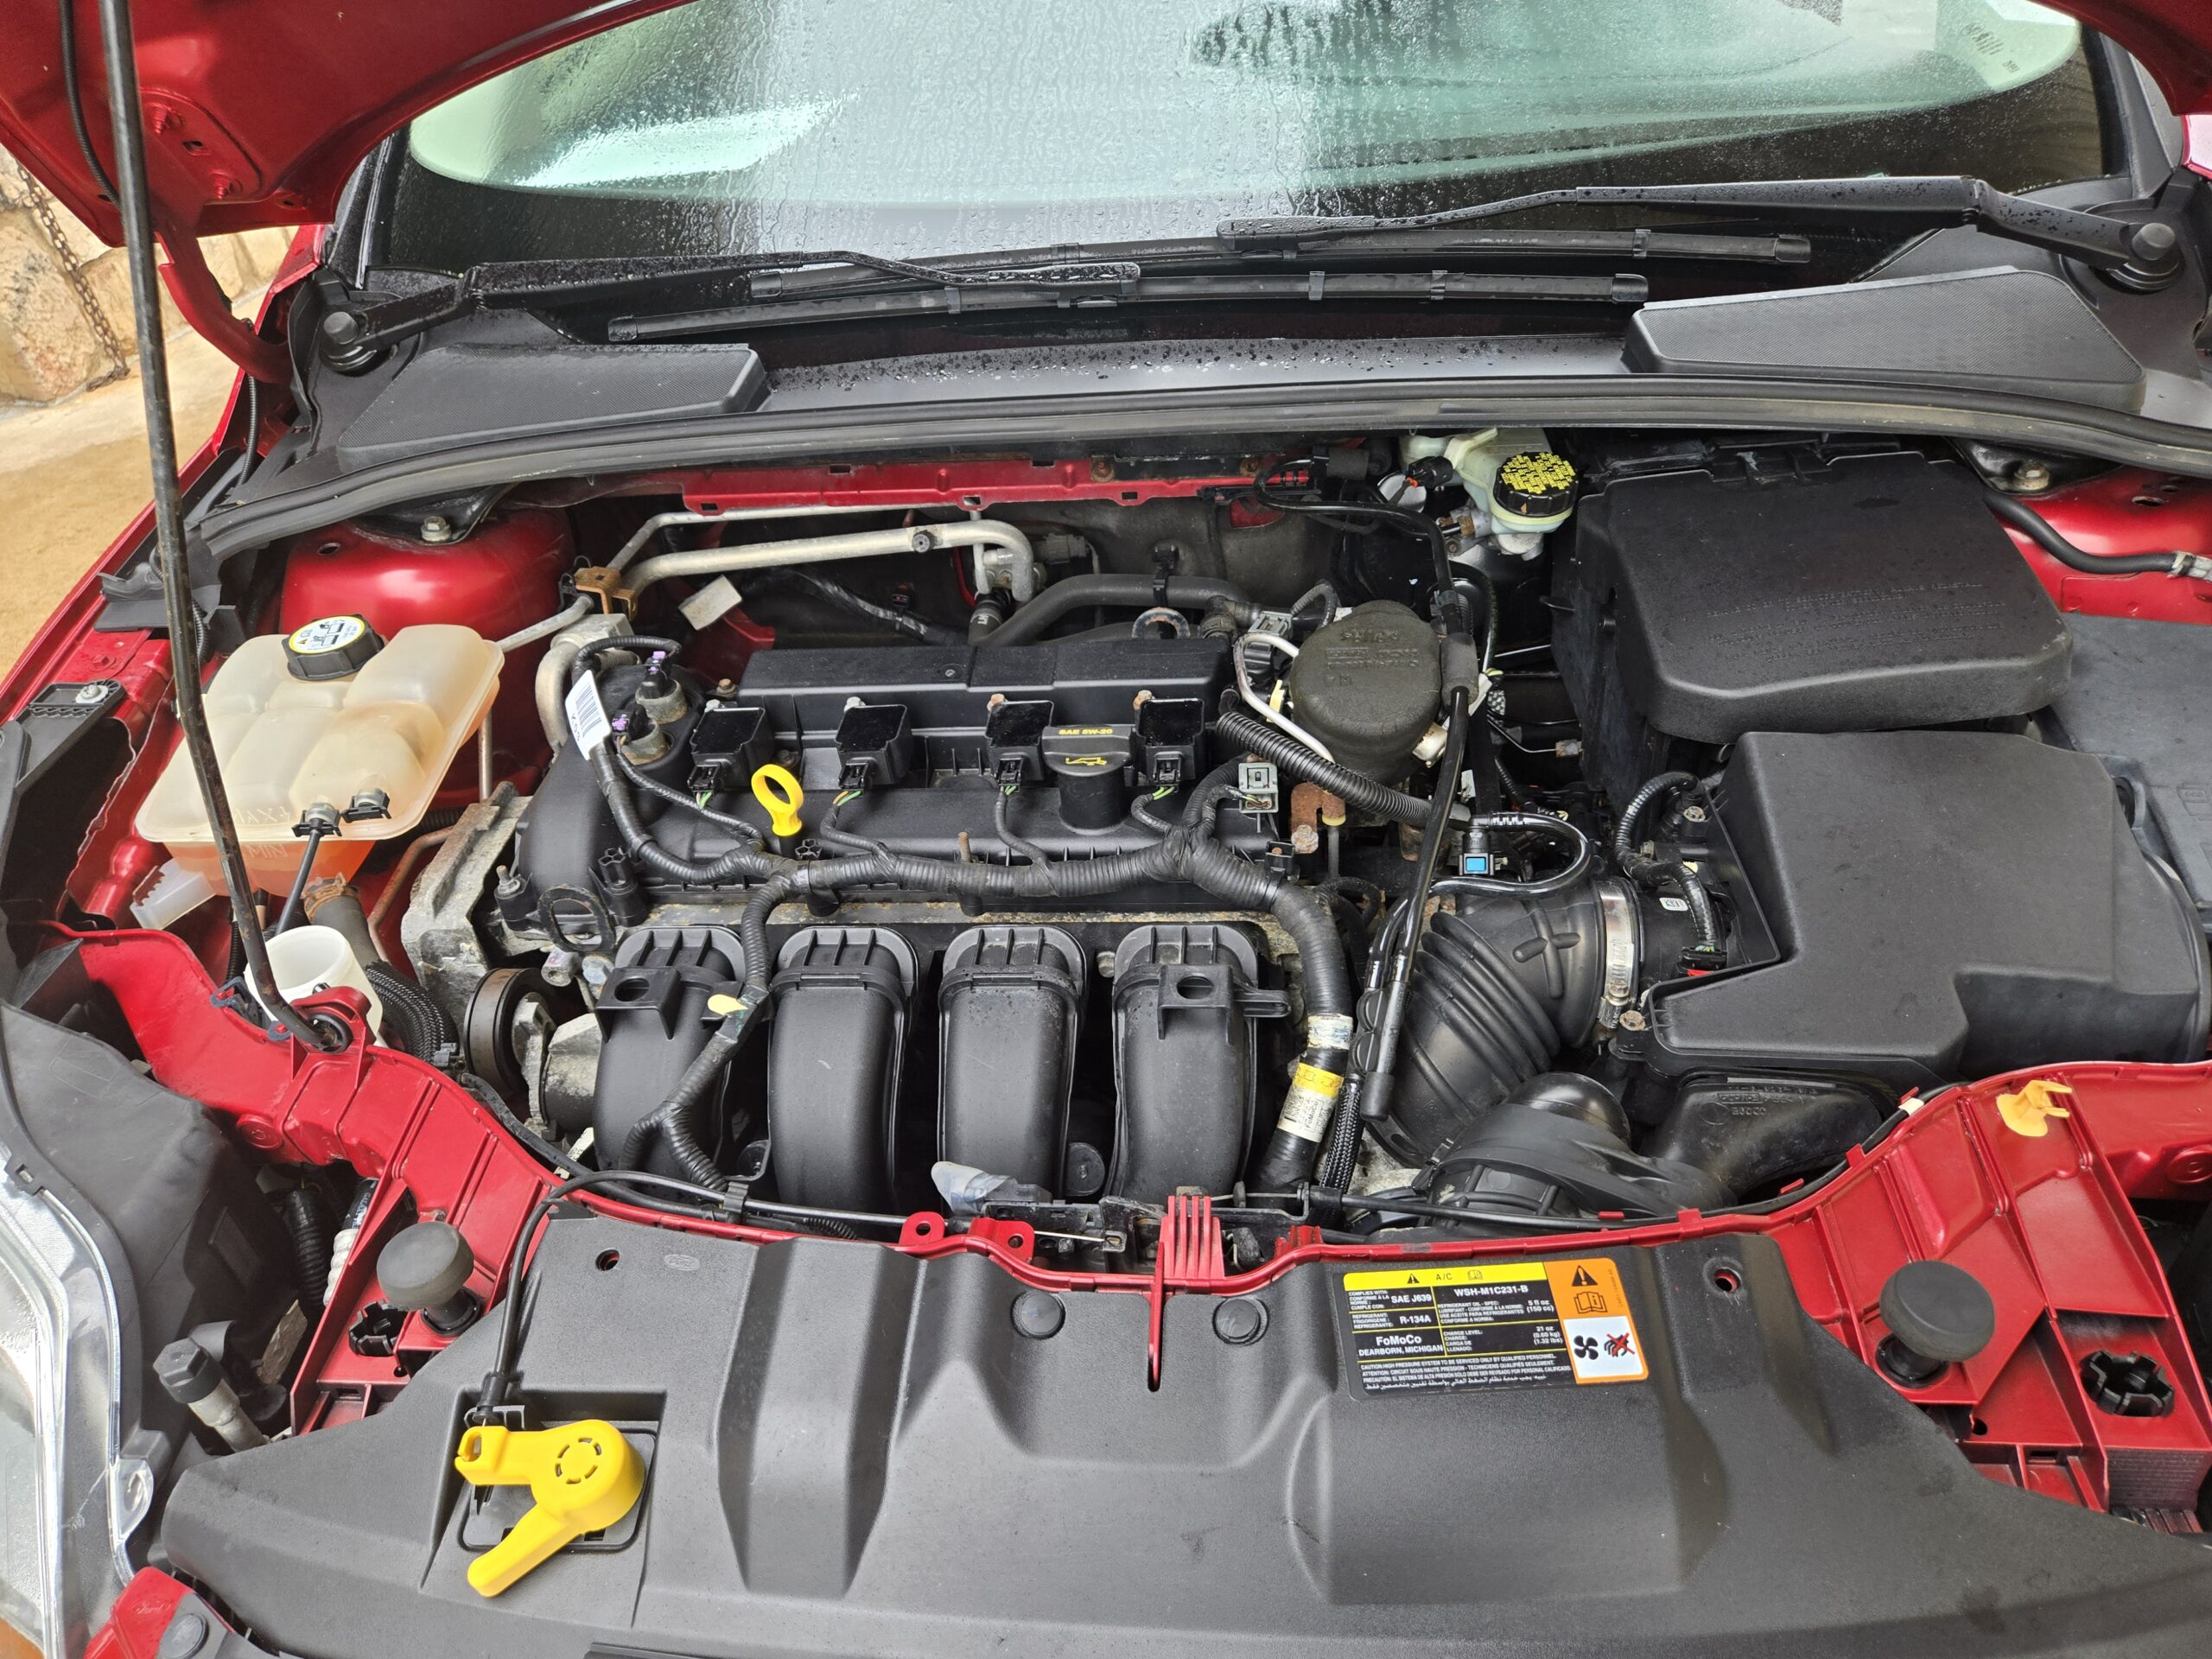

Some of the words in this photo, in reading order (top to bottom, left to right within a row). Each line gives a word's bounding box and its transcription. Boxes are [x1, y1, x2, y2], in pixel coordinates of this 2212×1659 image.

[245, 843, 289, 858] MIN
[1436, 1272, 1452, 1281] A/C
[1453, 1285, 1529, 1296] WSH-M1C231-B
[1391, 1295, 1410, 1303] SAE
[1412, 1294, 1432, 1303] J639
[1400, 1315, 1432, 1324] R-134A
[1376, 1335, 1422, 1346] FoMoCo
[1358, 1348, 1405, 1356] DEARBORN,
[1405, 1344, 1443, 1353] MICHIGAN
